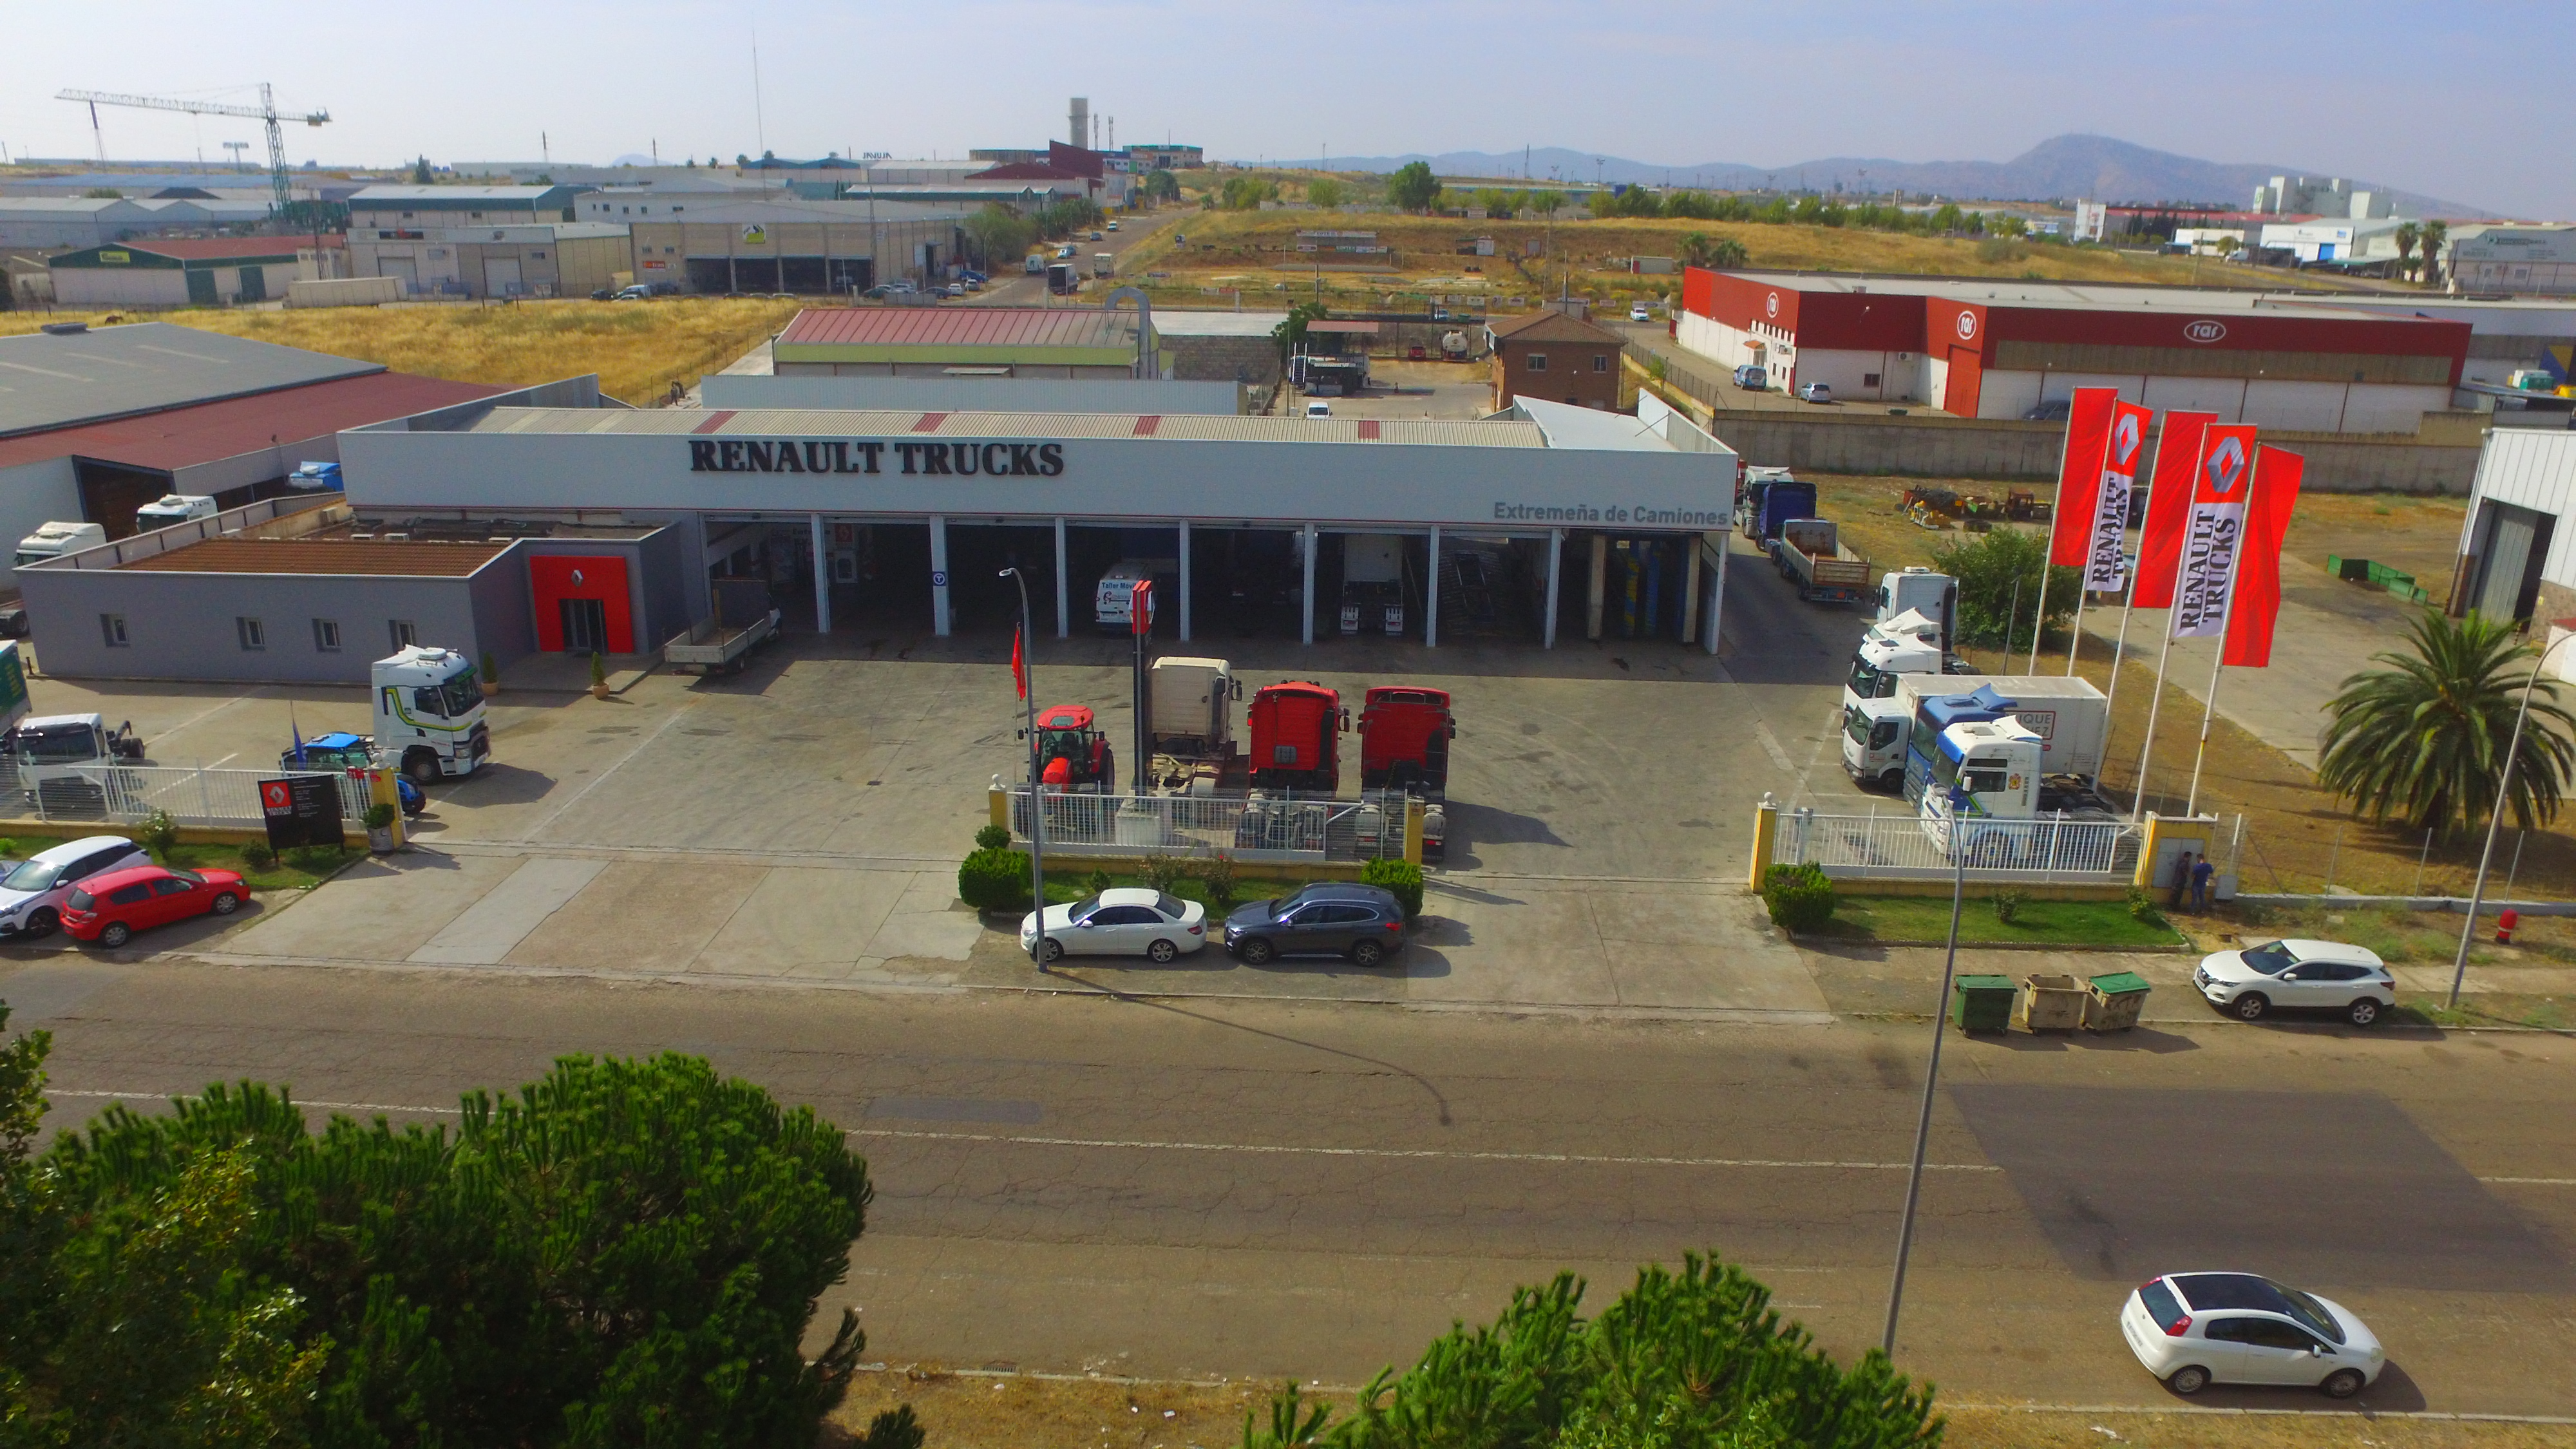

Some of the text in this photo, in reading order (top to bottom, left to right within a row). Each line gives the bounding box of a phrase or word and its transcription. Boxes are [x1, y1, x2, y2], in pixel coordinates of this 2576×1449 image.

[688, 440, 1065, 477] RENAULT TRUCKS
[1493, 502, 1728, 526] Extremeña de Camiones
[2180, 510, 2215, 629] RENAULT
[2202, 517, 2236, 622] TRUCKS
